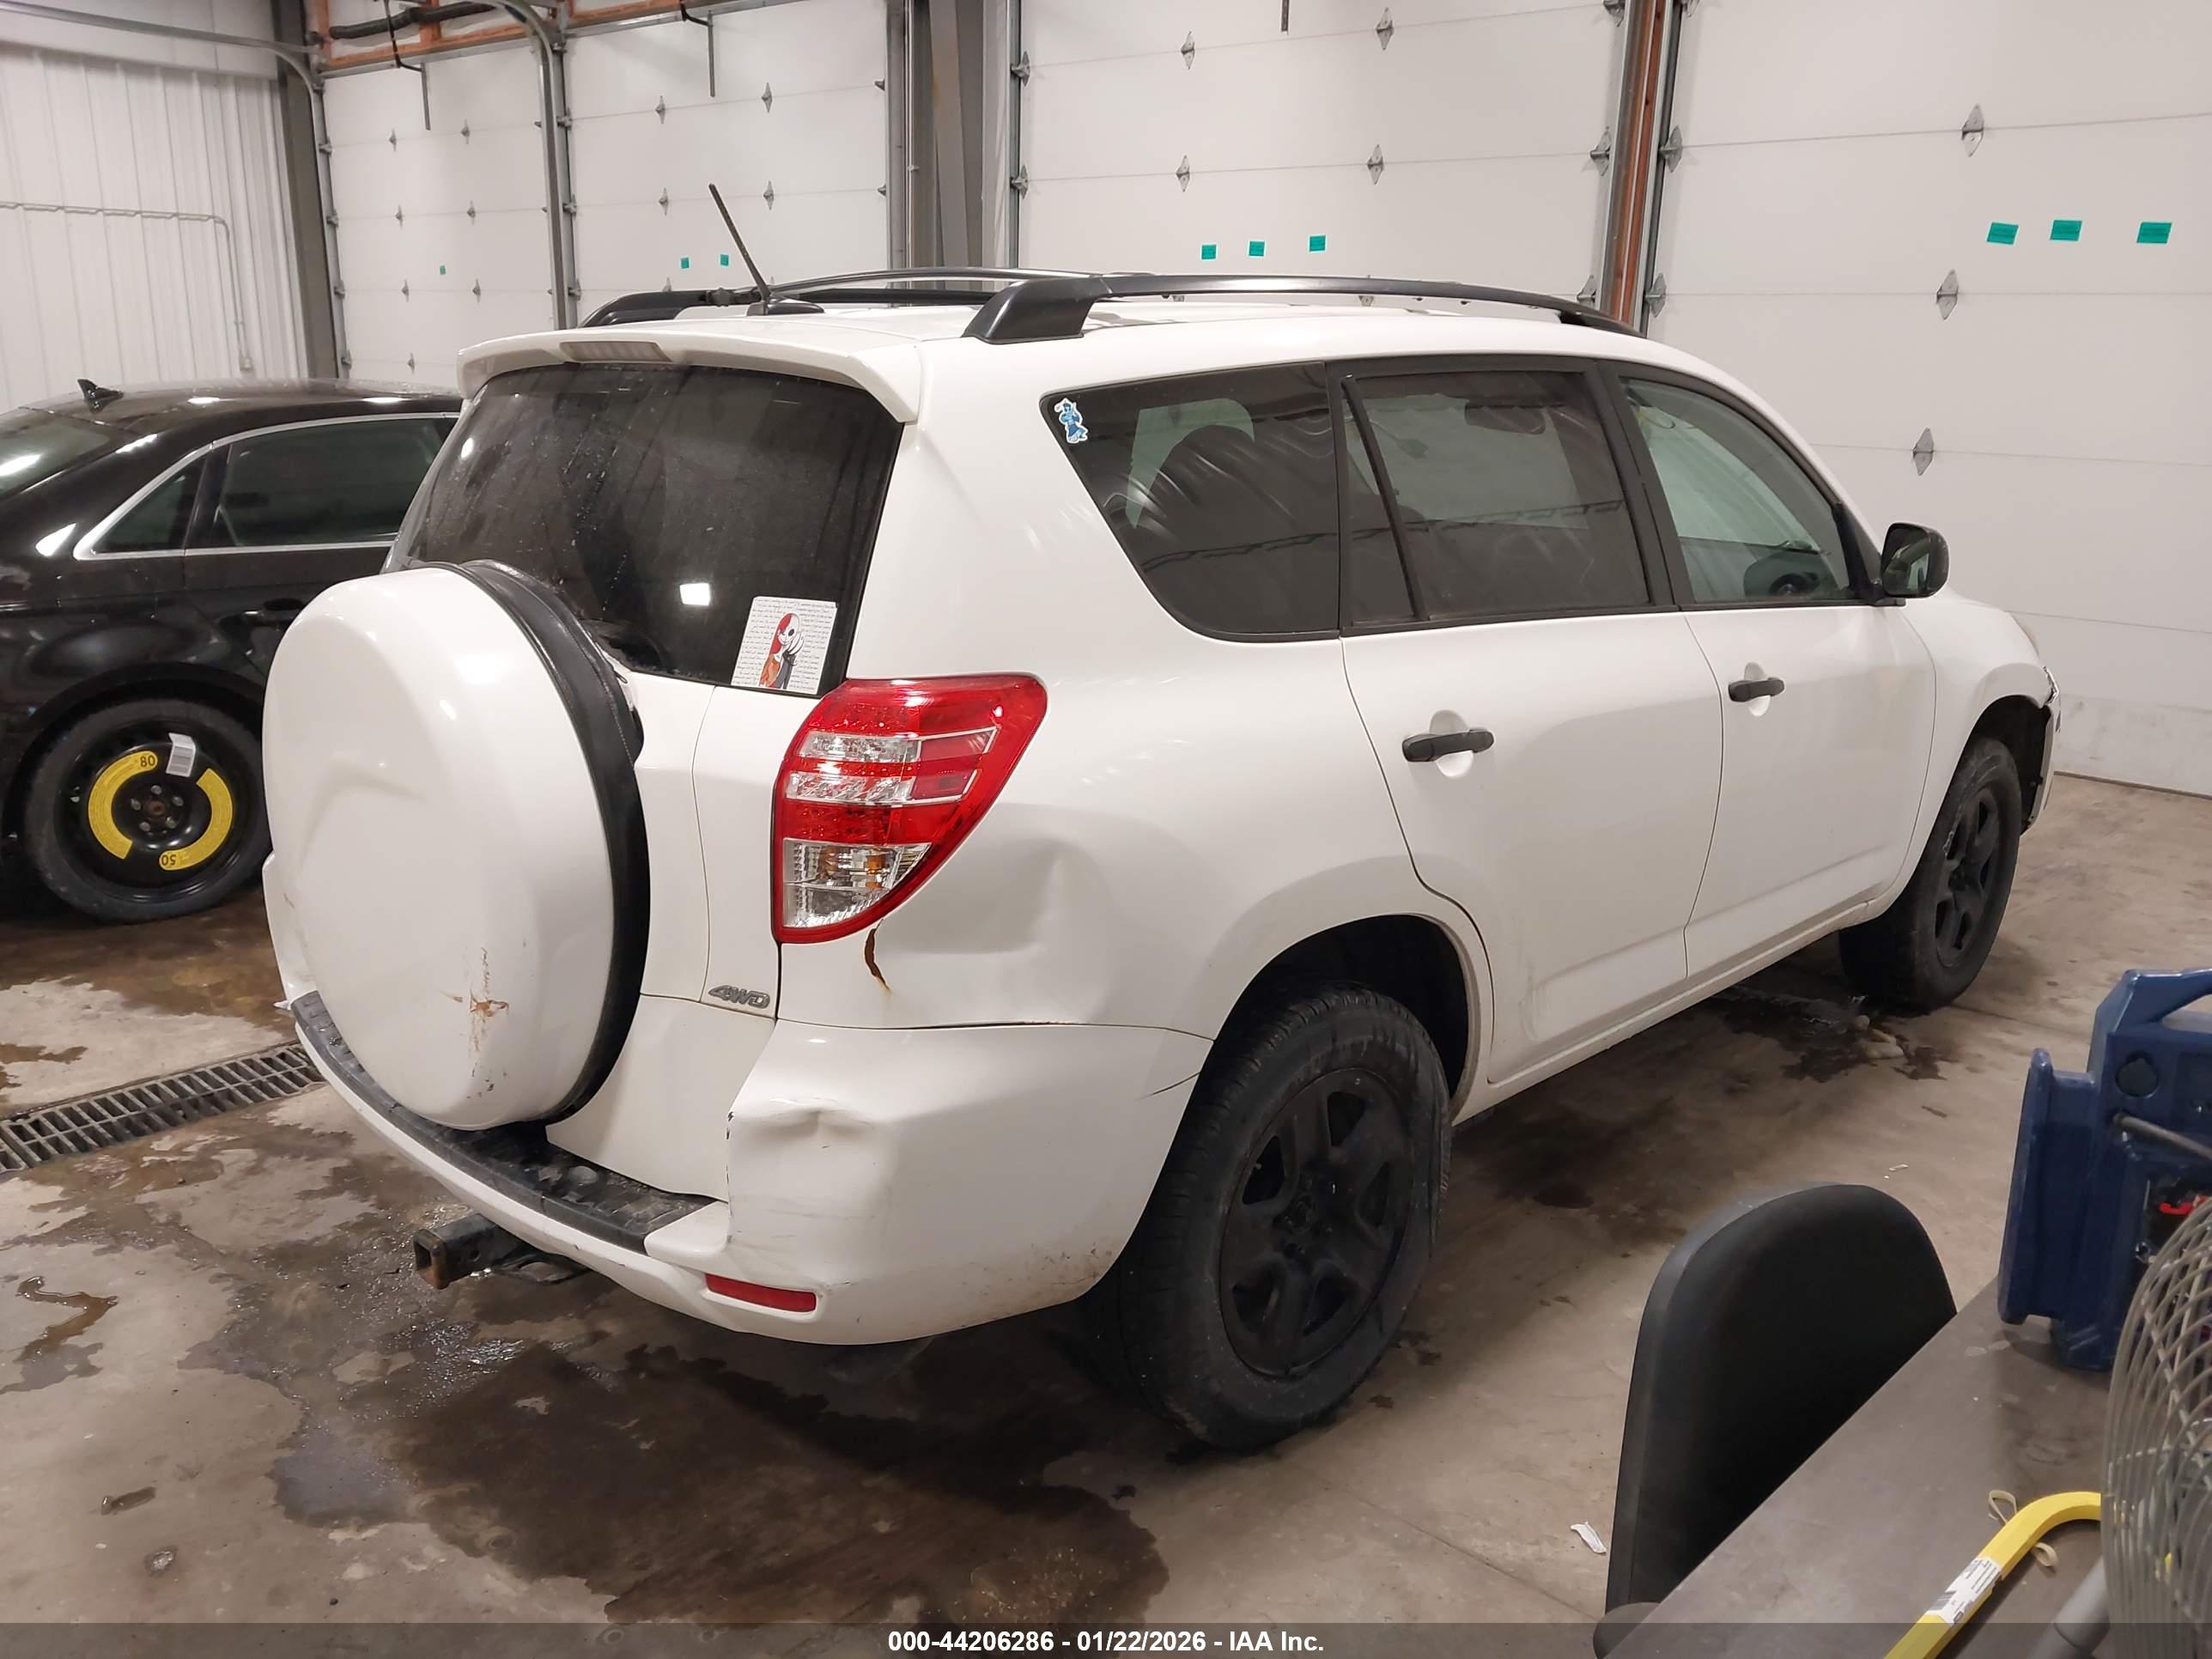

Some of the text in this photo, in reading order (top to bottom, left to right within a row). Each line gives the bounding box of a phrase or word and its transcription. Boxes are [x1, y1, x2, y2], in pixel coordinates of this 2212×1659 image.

[140, 756, 155, 768] 80
[161, 854, 176, 866] 50
[708, 985, 770, 1009] 4WD
